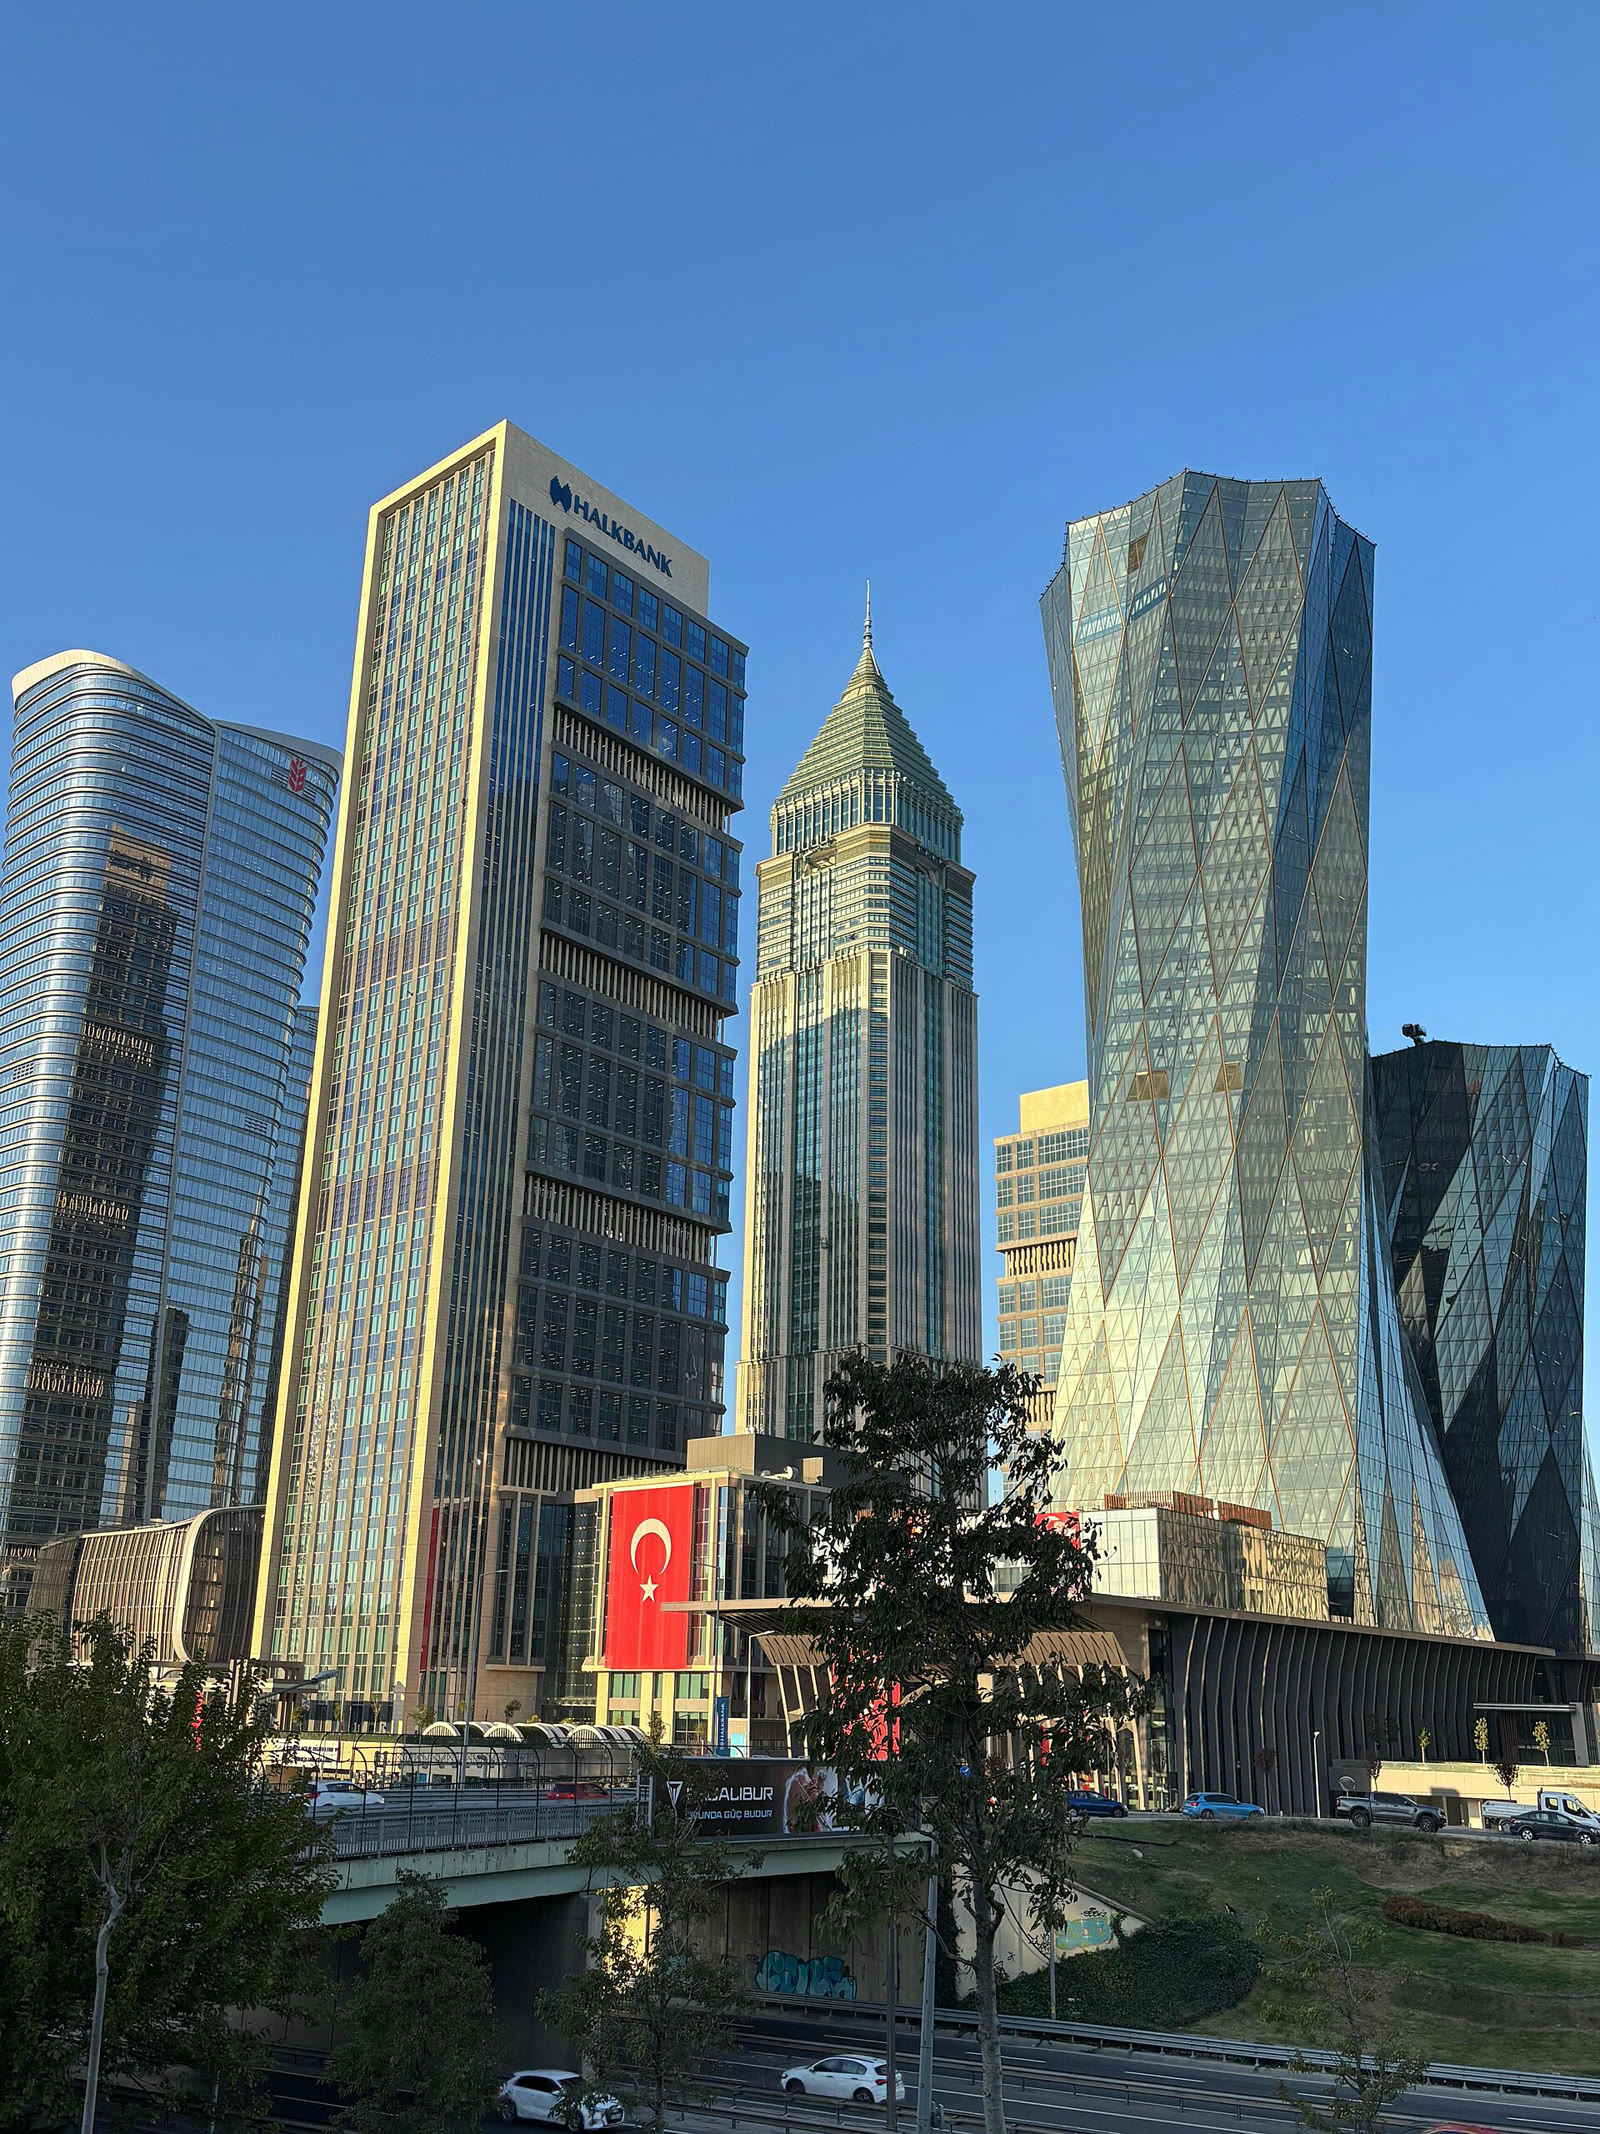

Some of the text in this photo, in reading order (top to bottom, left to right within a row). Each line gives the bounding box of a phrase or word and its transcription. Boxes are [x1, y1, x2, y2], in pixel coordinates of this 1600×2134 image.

[574, 494, 673, 578] HALKBANK
[724, 1809, 742, 1820] GÜÇ
[744, 1810, 773, 1818] BUDUR
